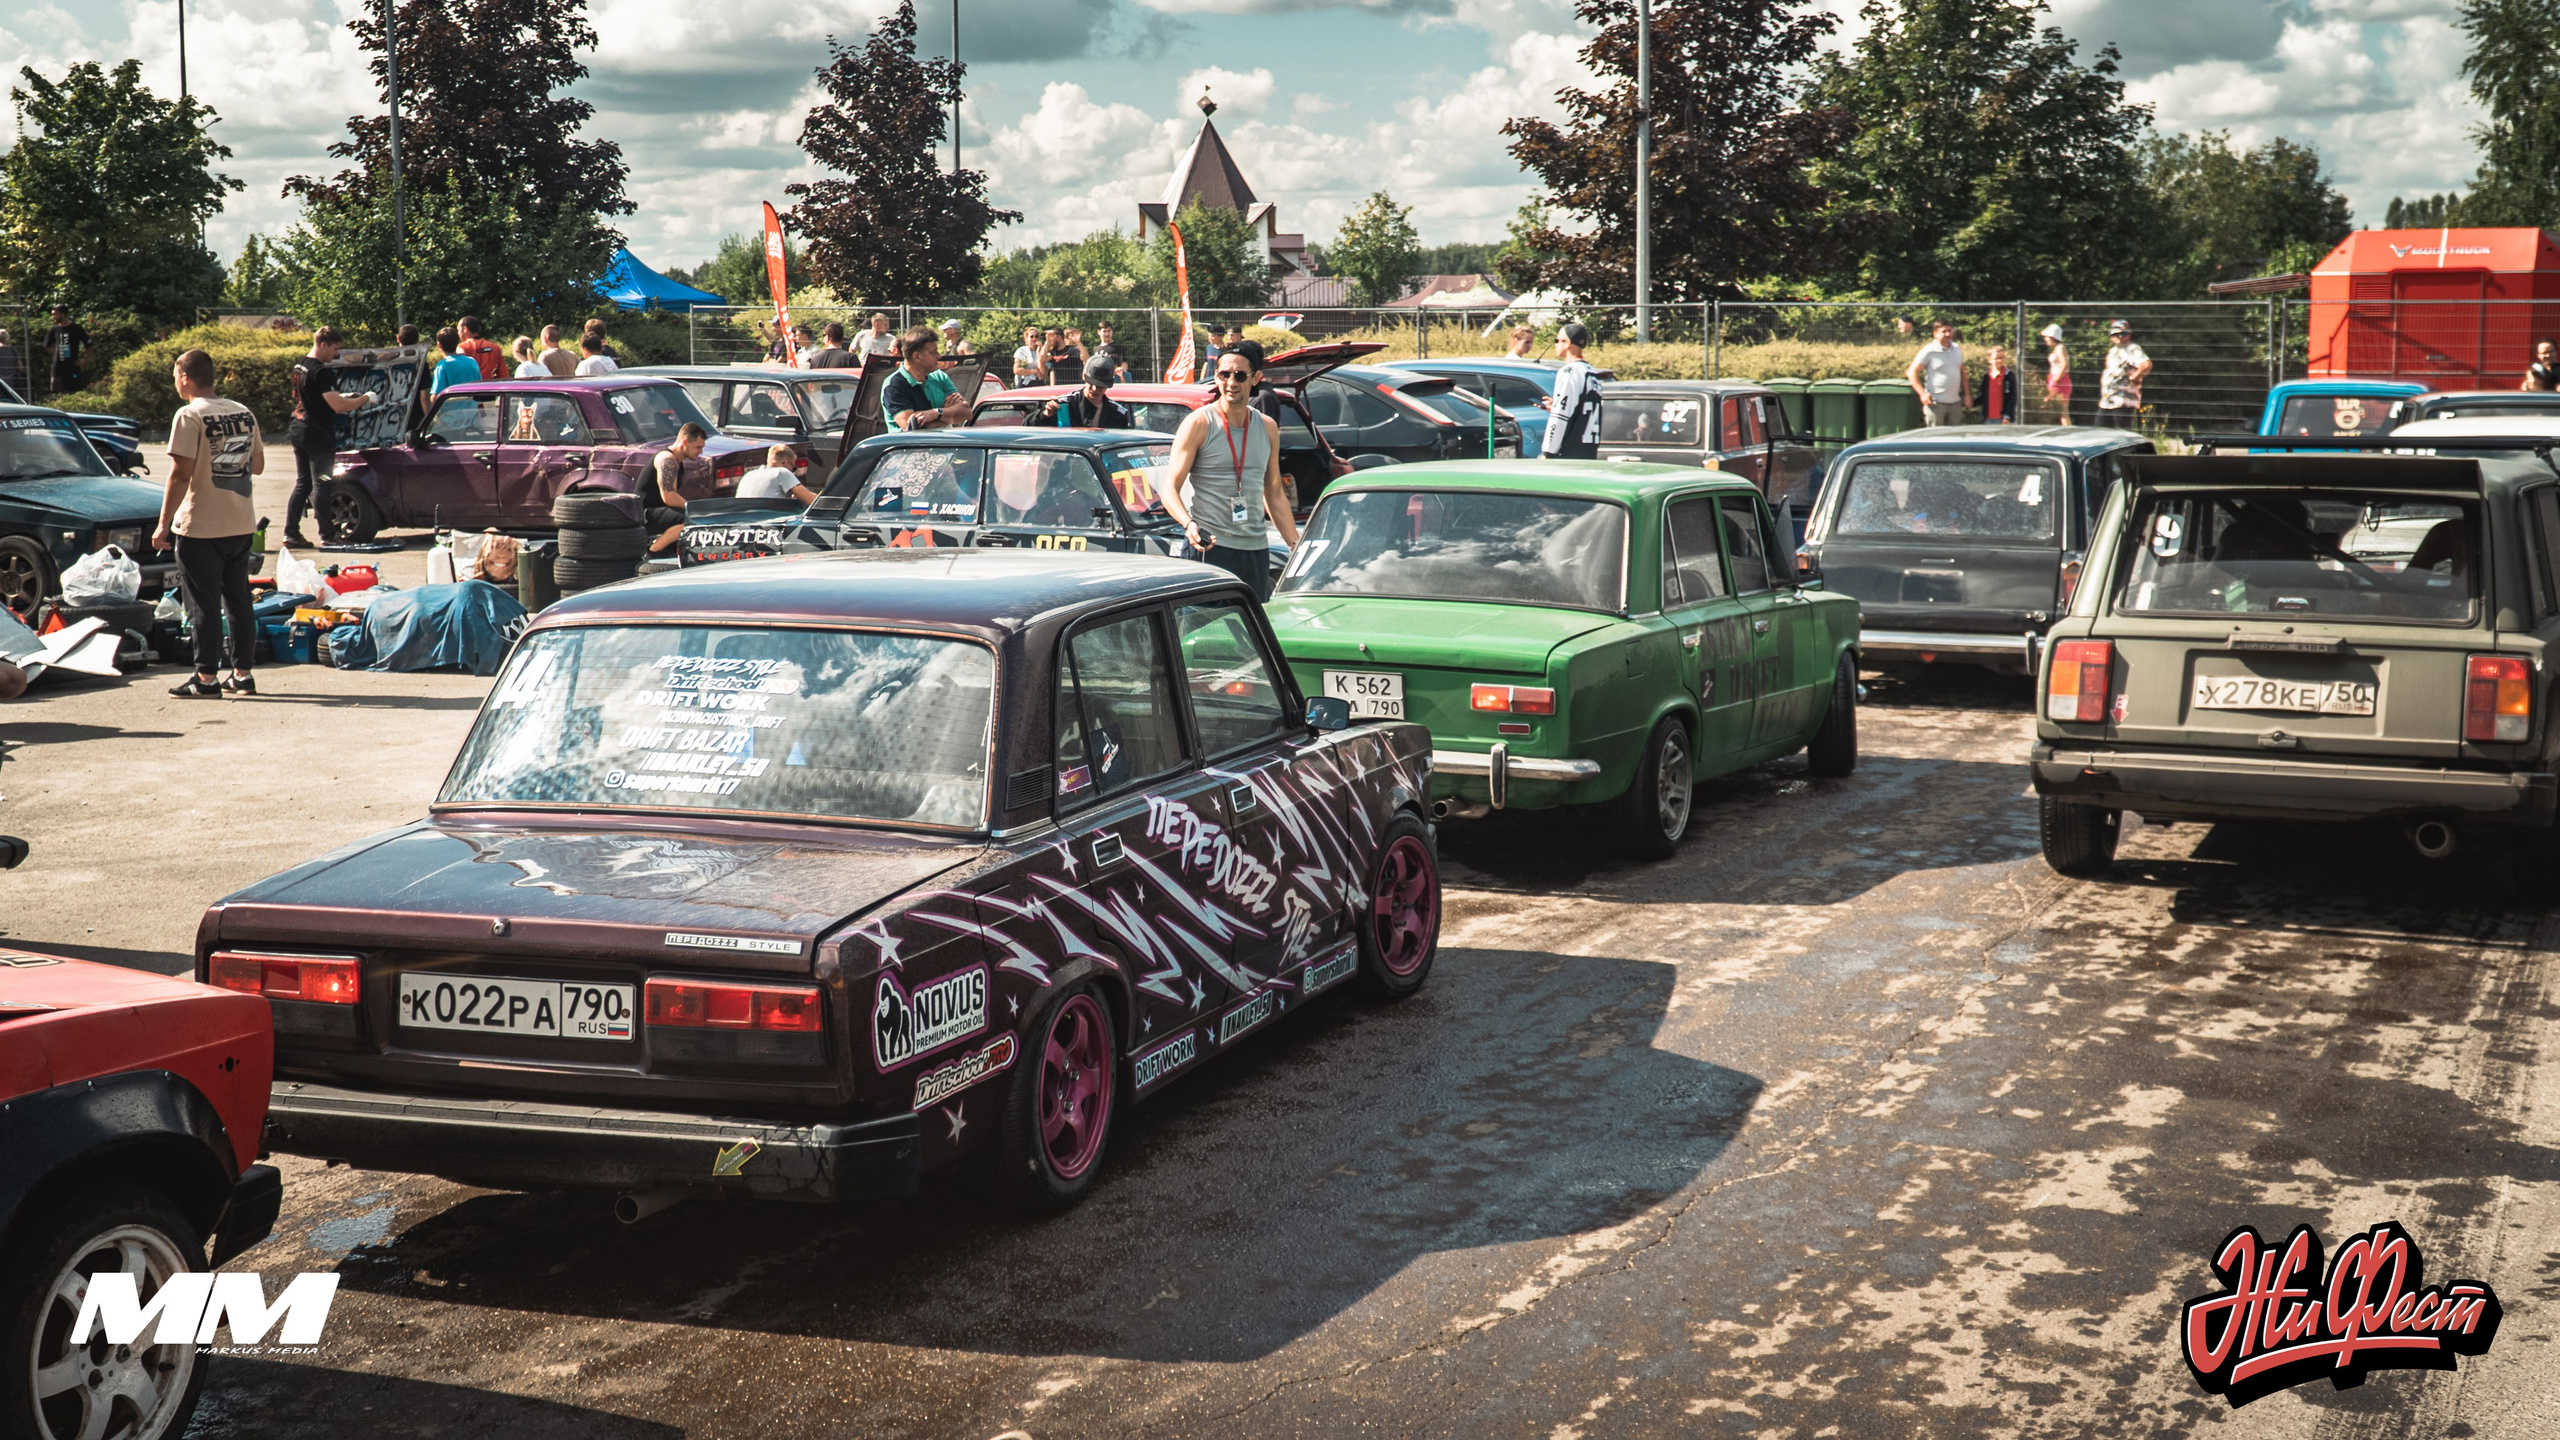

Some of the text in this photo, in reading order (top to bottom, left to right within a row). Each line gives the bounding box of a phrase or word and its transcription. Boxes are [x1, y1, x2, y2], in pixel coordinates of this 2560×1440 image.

[610, 396, 635, 415] 30
[1660, 401, 1687, 423] 32
[11, 418, 46, 428] SERIES
[1128, 457, 1151, 469] WET
[1111, 469, 1153, 506] 77
[2018, 474, 2043, 506] 4
[1285, 540, 1331, 578] 17
[490, 650, 557, 709] 14
[1356, 676, 1391, 696] 562
[636, 690, 771, 711] DRIFT WORK
[2322, 684, 2366, 704] 750
[1371, 700, 1399, 715] 790
[2331, 702, 2352, 711] RUS
[618, 726, 750, 754] DRIFT BAZAR
[749, 941, 791, 951] STYLE
[564, 986, 623, 1021] 790
[915, 971, 984, 1034] NOVUS
[578, 1022, 607, 1034] RUS
[916, 1014, 984, 1050] PREMIUM MOTOR OIL
[1136, 1033, 1195, 1088] DRIFT WORK
